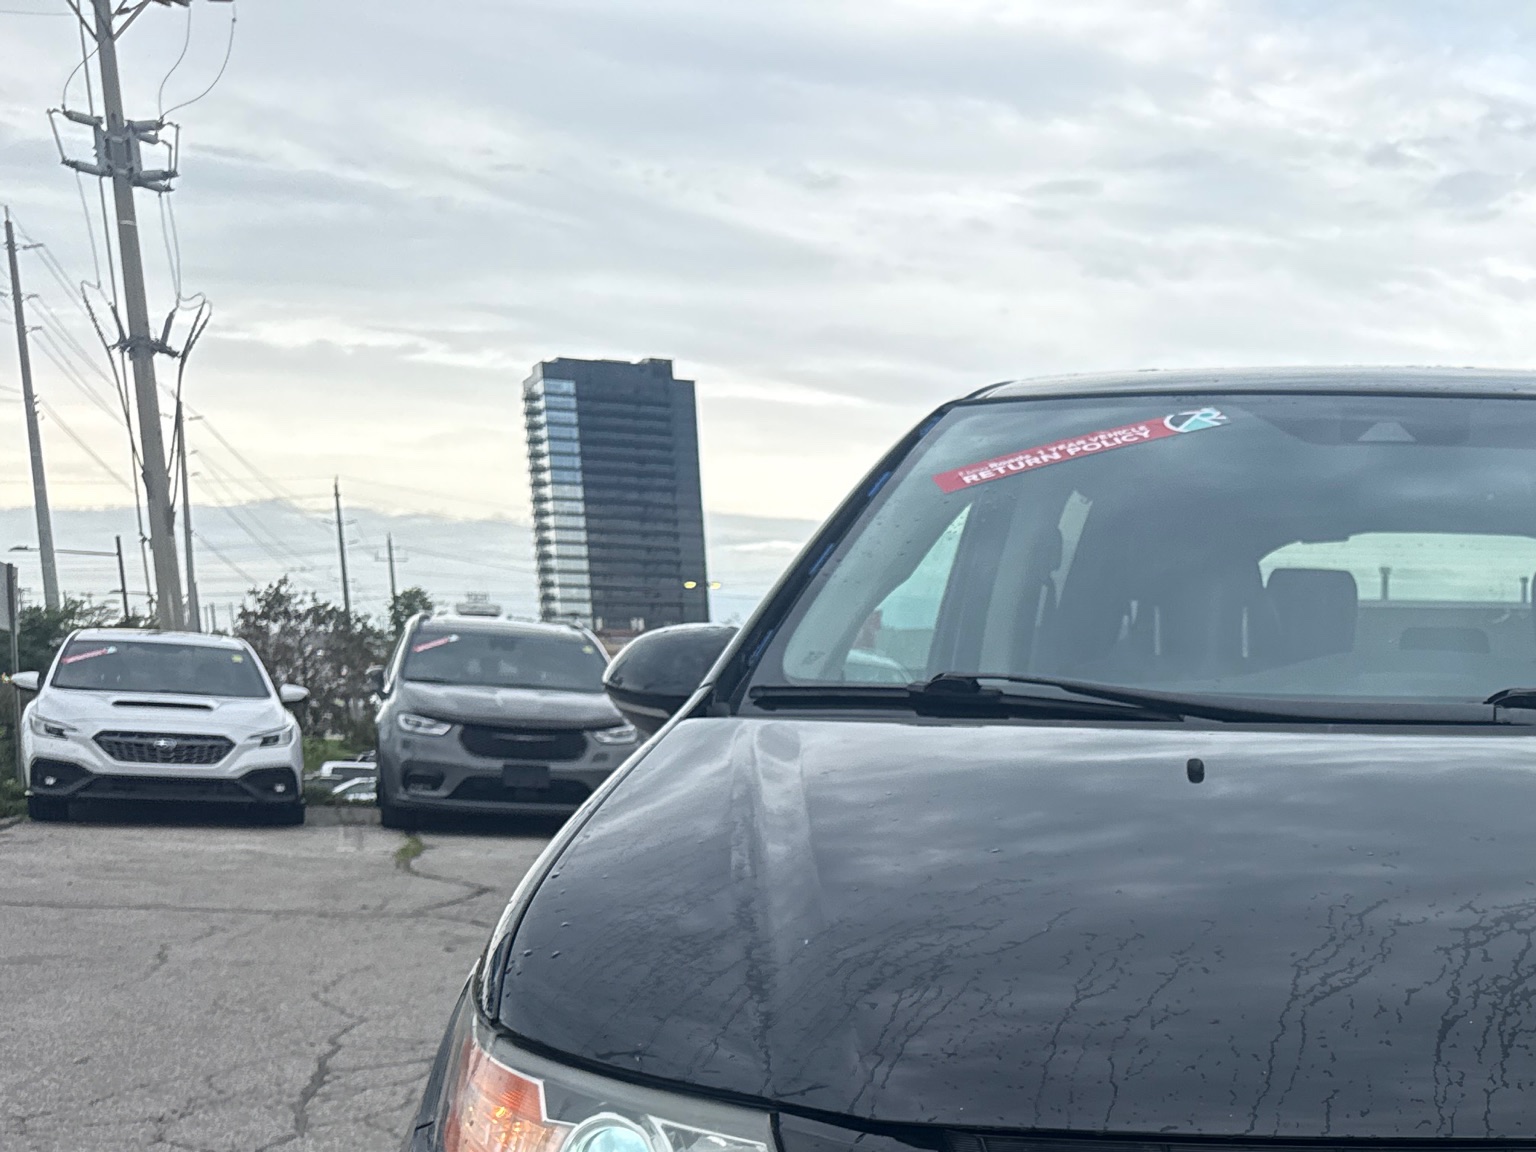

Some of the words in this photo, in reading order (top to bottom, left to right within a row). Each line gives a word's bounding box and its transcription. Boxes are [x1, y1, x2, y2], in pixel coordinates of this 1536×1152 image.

[1089, 426, 1148, 442] VEHICLE
[963, 452, 1062, 484] RETURN
[1066, 429, 1151, 456] POLICY
